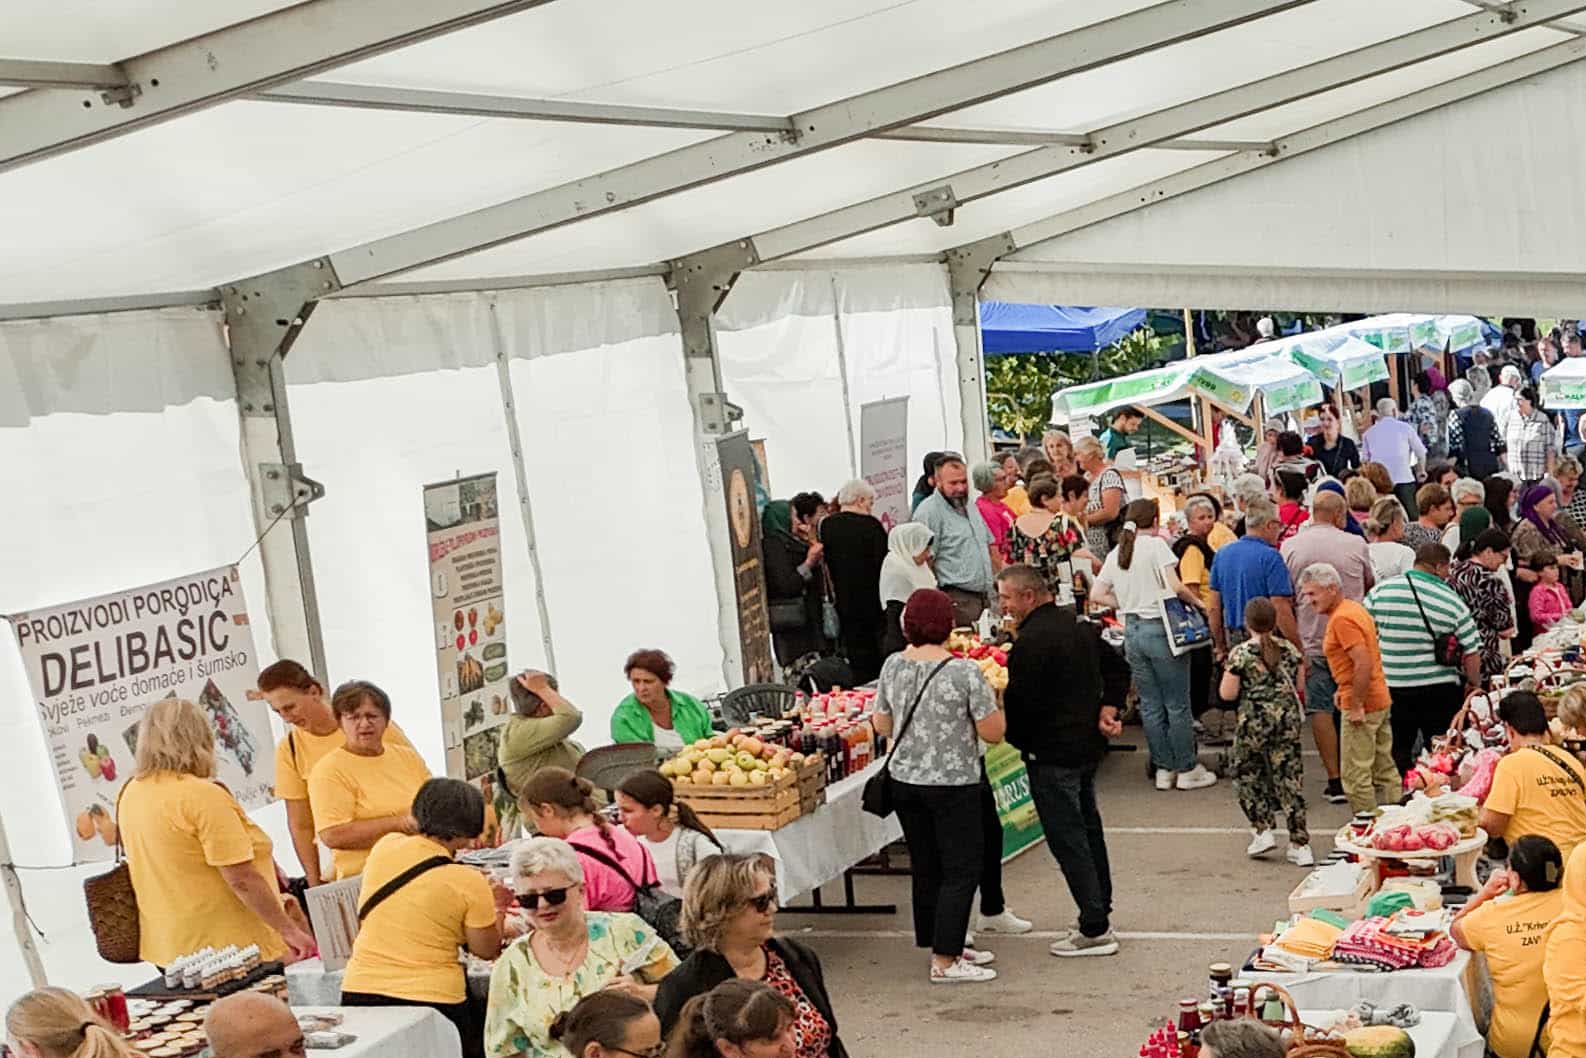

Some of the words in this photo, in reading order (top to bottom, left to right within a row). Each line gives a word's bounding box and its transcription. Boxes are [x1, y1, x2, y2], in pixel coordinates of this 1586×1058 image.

[17, 599, 131, 648] PROIZVODI
[134, 575, 233, 616] PORODICA
[41, 598, 229, 698] DELIBAŠIĆ
